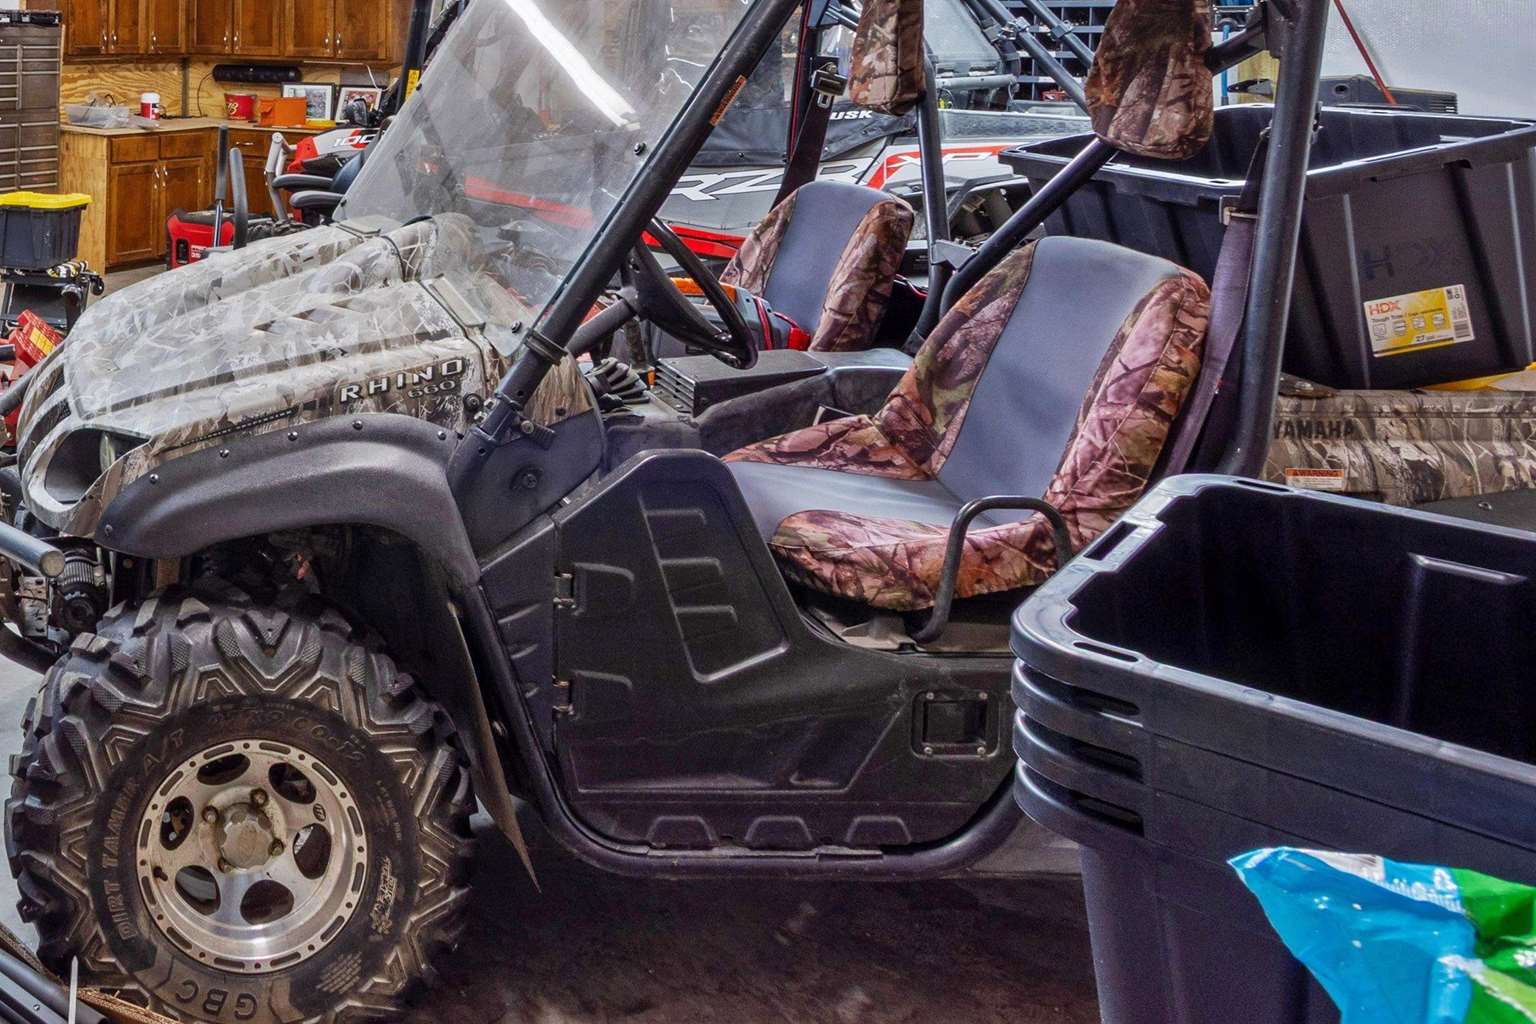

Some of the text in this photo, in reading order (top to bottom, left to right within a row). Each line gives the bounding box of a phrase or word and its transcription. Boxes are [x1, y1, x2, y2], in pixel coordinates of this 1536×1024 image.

[830, 109, 872, 121] USK
[1368, 301, 1401, 316] HDX
[340, 359, 465, 403] RHINO
[407, 379, 456, 399] 660
[1273, 419, 1355, 439] YAMAHA
[175, 978, 259, 1021] GBC
